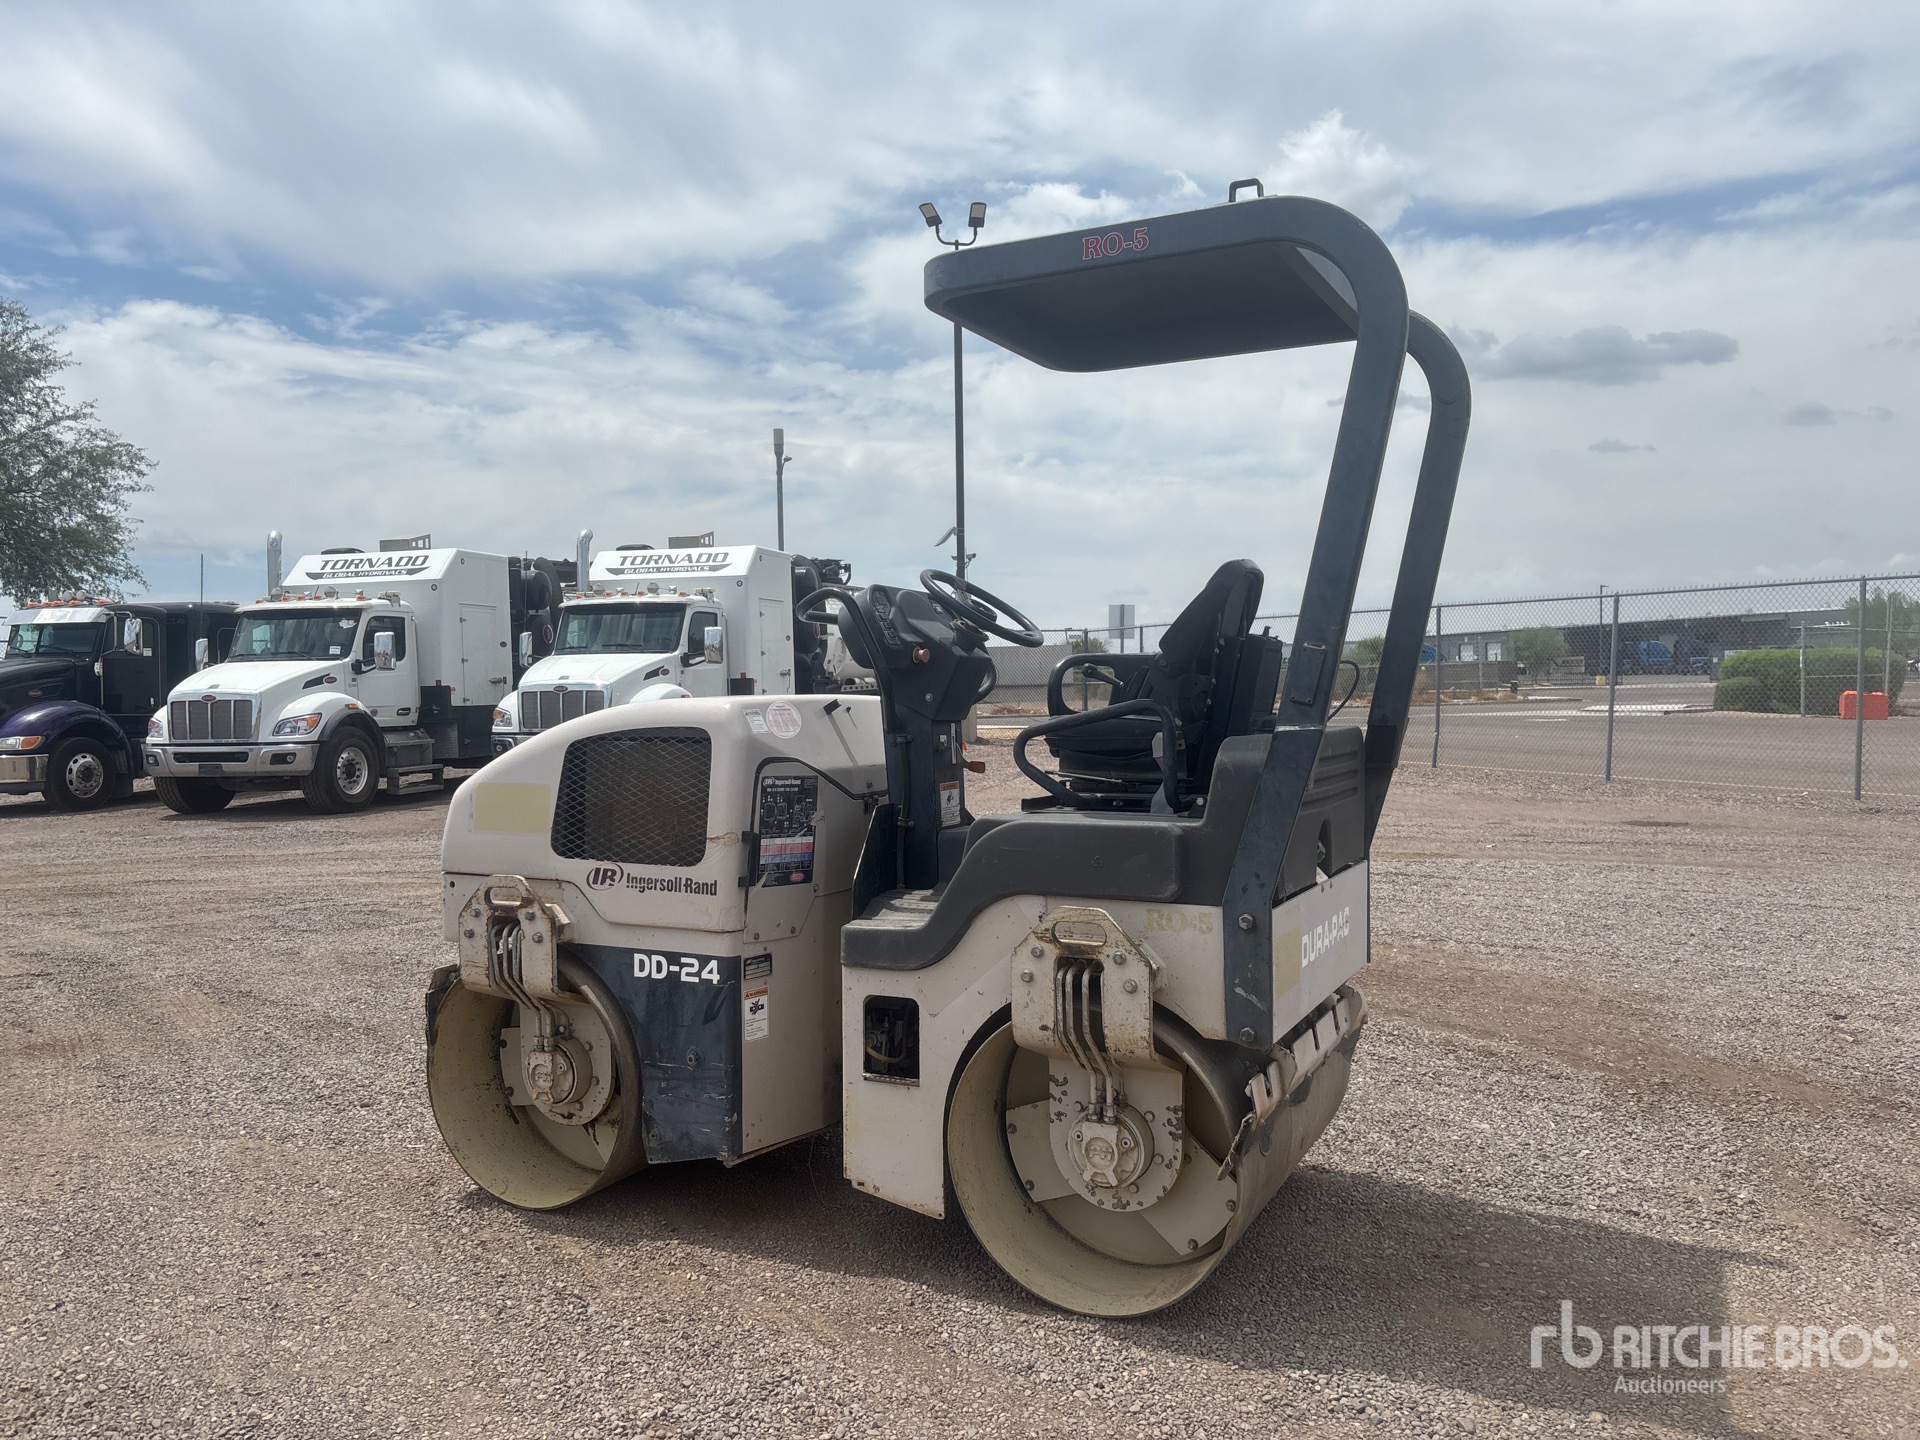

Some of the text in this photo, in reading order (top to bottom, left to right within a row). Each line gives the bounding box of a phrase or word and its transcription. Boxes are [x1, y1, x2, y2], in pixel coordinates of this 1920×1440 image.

[1082, 227, 1149, 260] RO-5
[320, 555, 430, 571] TORNADO
[619, 552, 729, 567] TORNADO
[322, 569, 408, 579] GLOBAL HYDROVACS
[624, 565, 710, 574] GLOBAL HYDROVACS
[633, 953, 720, 985] DD-24
